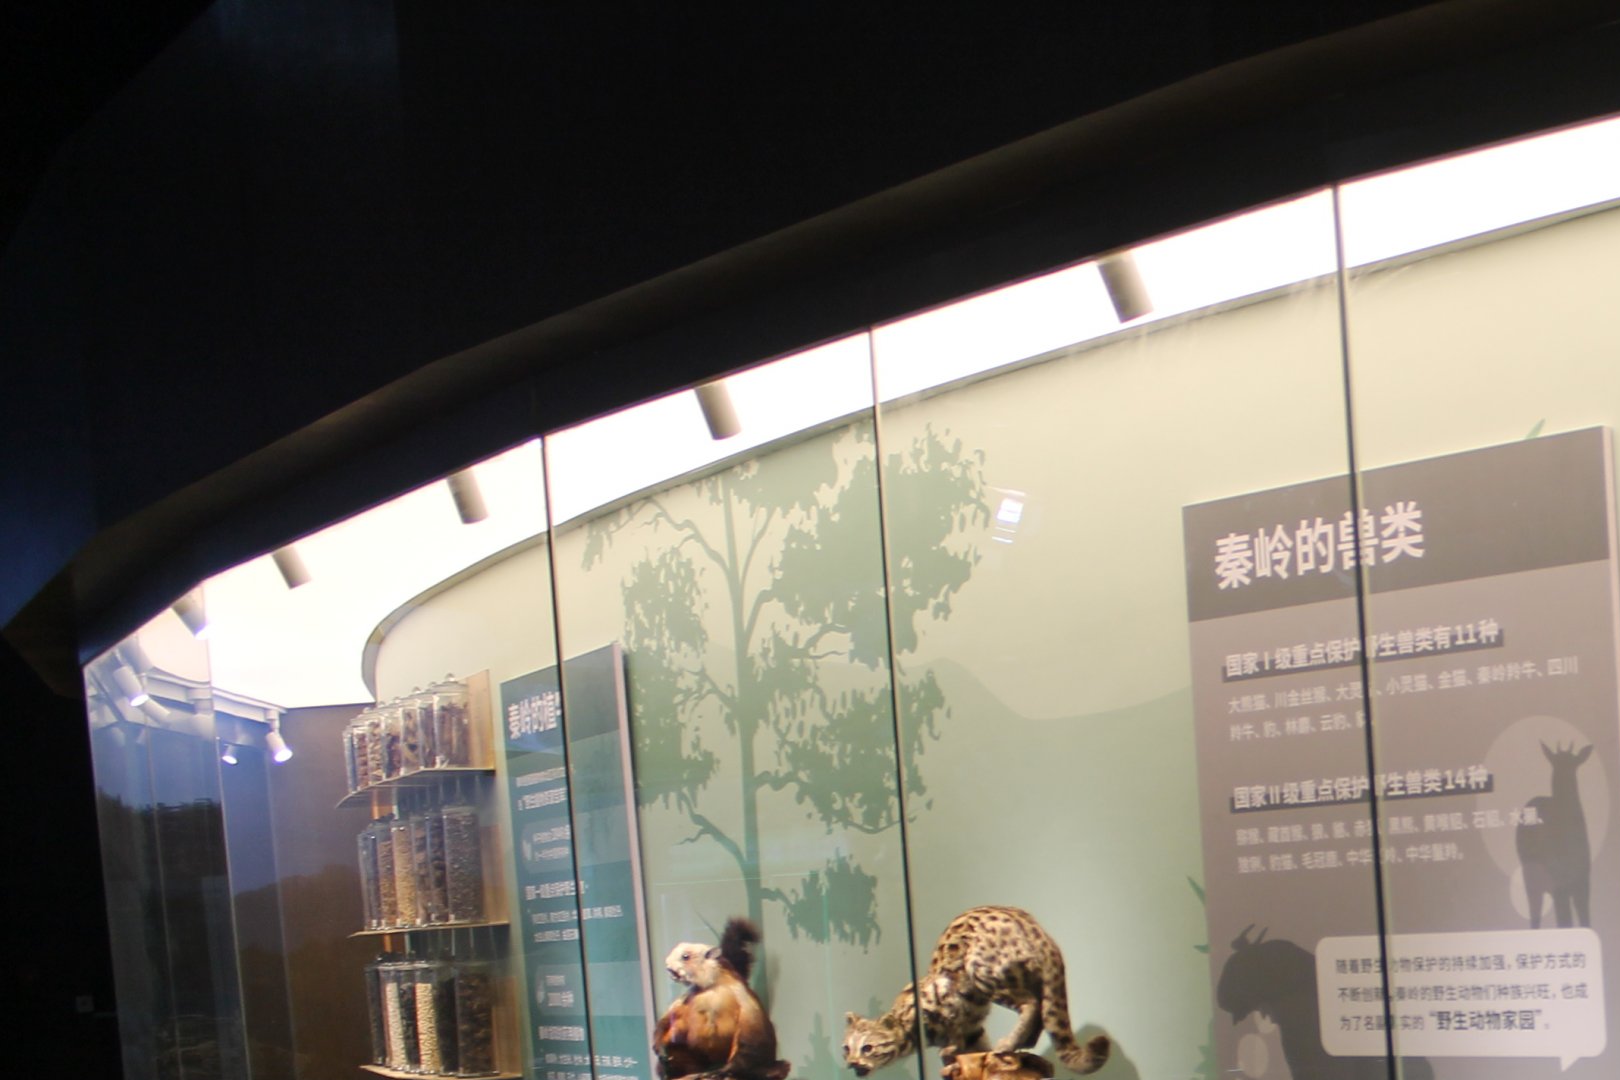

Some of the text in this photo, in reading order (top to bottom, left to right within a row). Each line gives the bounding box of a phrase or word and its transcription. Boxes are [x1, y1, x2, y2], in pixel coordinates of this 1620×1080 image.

[1214, 500, 1426, 590] 秦岭的兽类
[1228, 655, 1579, 714] 大熊猫、川金丝猴、大灵、小灵猫、金猫、秦岭羚牛、四川
